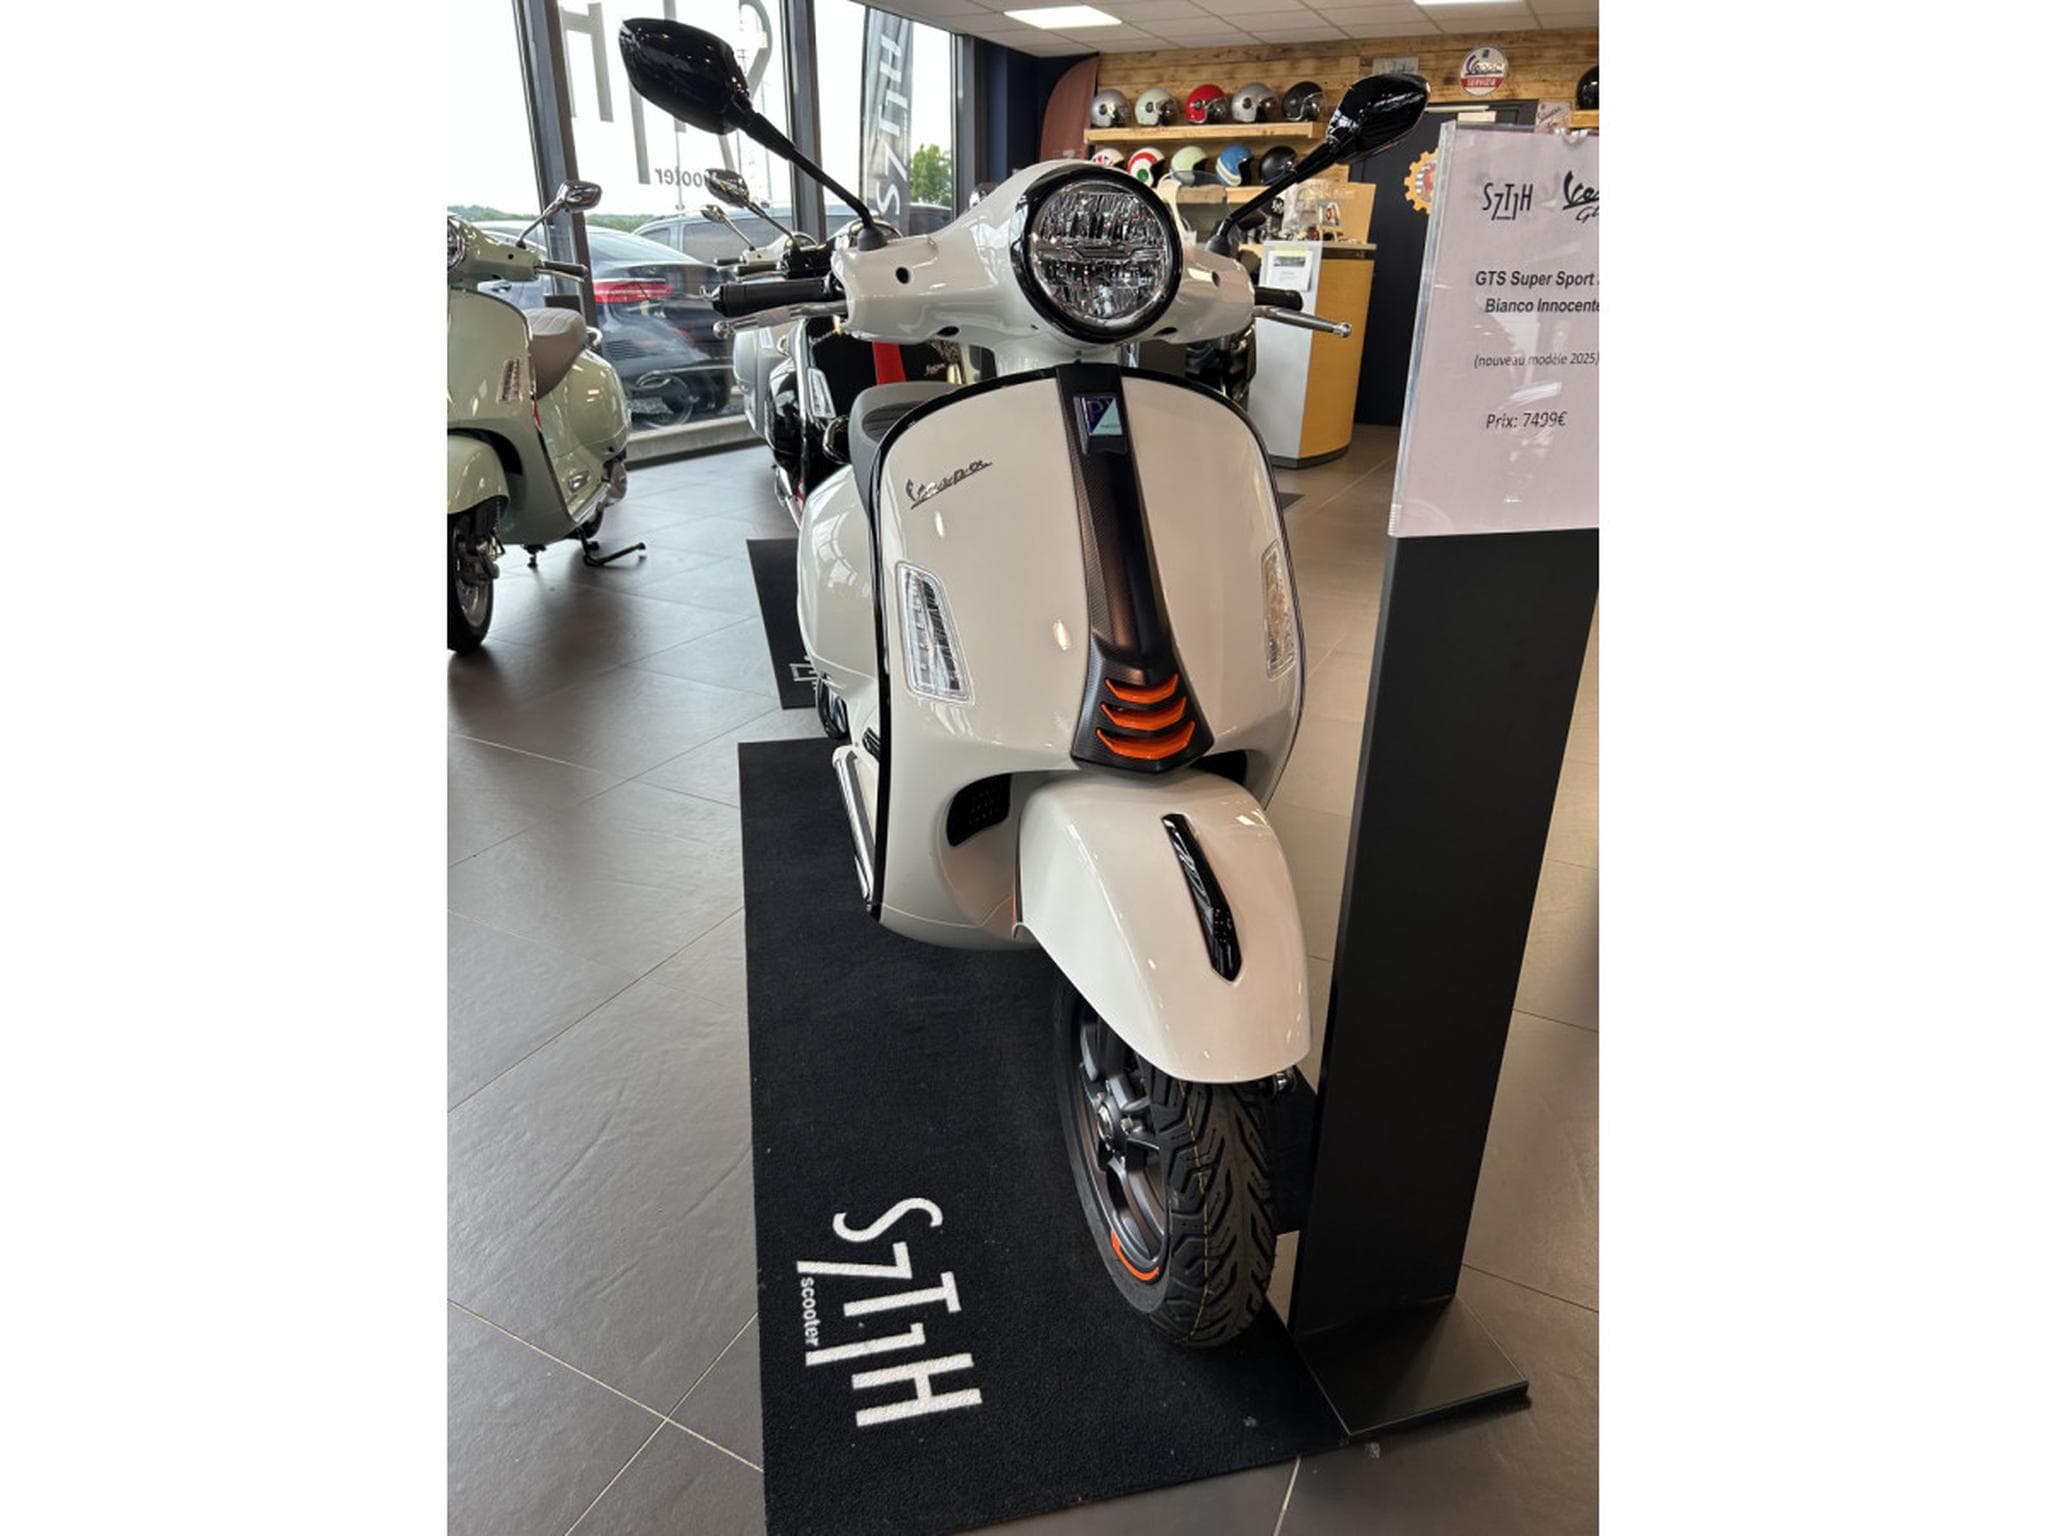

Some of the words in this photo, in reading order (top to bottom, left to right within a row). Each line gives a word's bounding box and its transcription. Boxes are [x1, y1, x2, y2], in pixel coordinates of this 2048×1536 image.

[1562, 170, 1599, 210] Ve
[1475, 270, 1506, 286] GTS
[1510, 270, 1553, 289] Super
[1555, 270, 1595, 289] Sport
[1485, 298, 1534, 313] Bianco
[1474, 355, 1526, 368] (nouveau
[1528, 353, 1568, 366] modèle
[1570, 352, 1599, 365] 2025)
[1486, 412, 1518, 429] Prix:
[1523, 410, 1568, 428] 7499€
[801, 1276, 821, 1347] scooter
